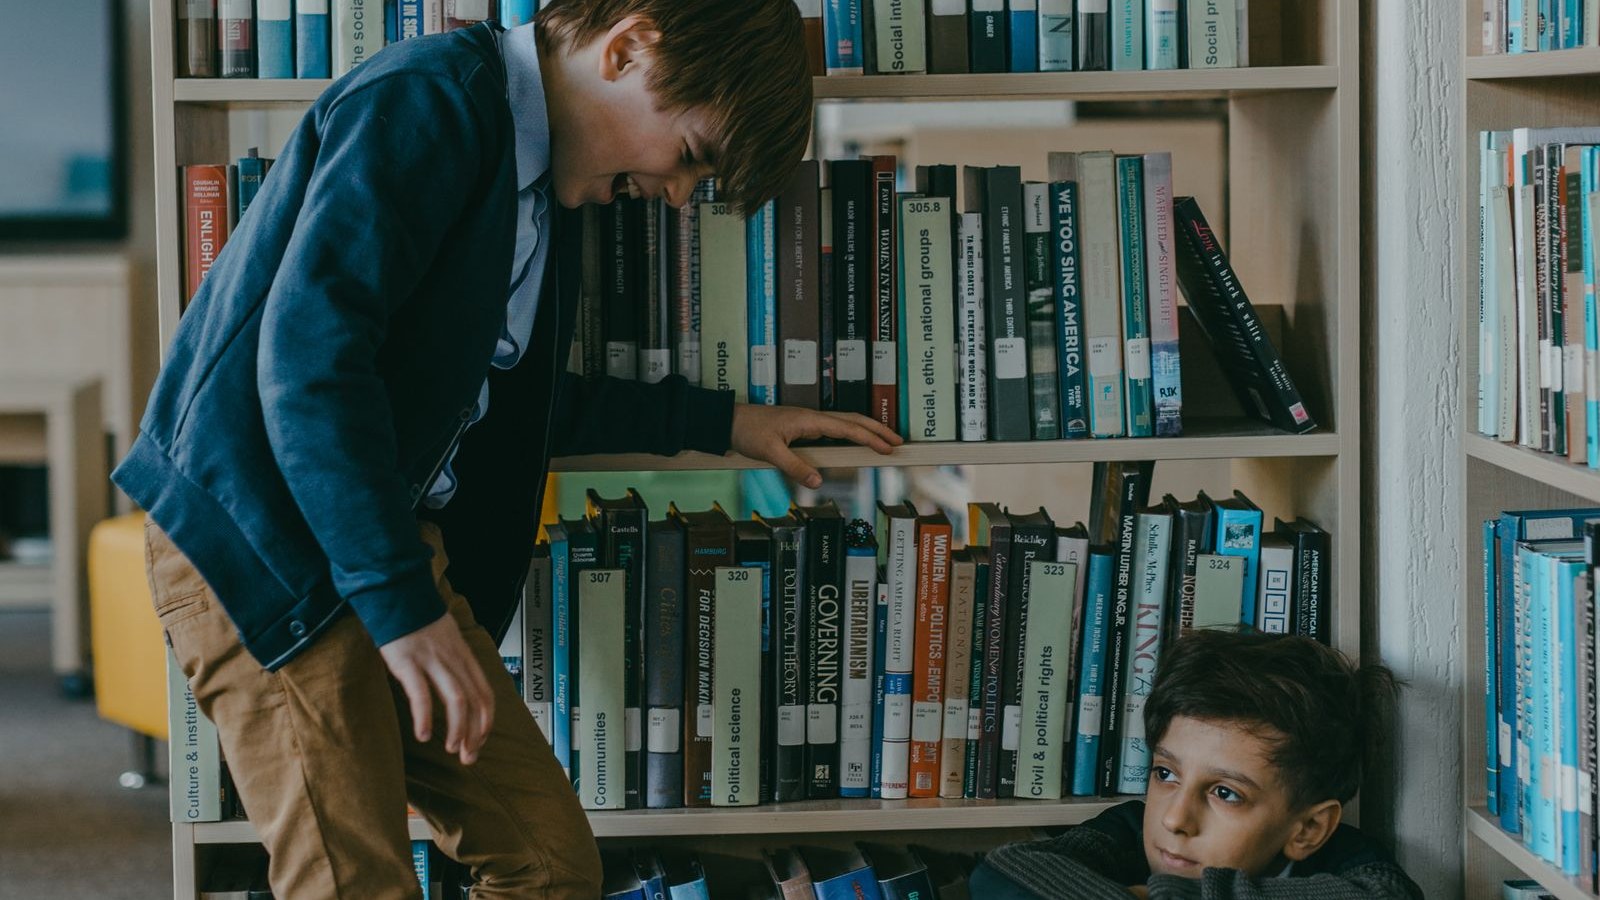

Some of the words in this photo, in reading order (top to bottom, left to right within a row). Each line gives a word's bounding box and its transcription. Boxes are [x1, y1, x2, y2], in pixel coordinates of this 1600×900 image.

[350, 0, 364, 40] socia
[403, 5, 417, 16] IN
[891, 27, 905, 71] Social
[1206, 20, 1217, 64] Social
[1127, 165, 1136, 181] THE
[908, 201, 941, 213] 305.8
[1057, 188, 1072, 214] WE
[1551, 166, 1561, 218] Principles
[846, 201, 856, 220] MAJOR
[1001, 206, 1010, 227] ETHNIC
[1127, 183, 1139, 246] INTERNATIONAL
[1155, 186, 1167, 241] MARRIED
[1552, 218, 1562, 232] of
[847, 222, 856, 253] PROBLEMS
[1058, 215, 1073, 254] TOO
[1537, 203, 1546, 260] FINANCING
[795, 242, 804, 269] LIBERTY
[880, 228, 891, 269] WOMEN
[921, 229, 935, 279] groups
[1549, 233, 1561, 290] Budgetary
[847, 264, 856, 291] AMERICAN
[880, 271, 891, 286] IN
[967, 270, 975, 297] COATES
[1003, 265, 1012, 291] AMERICA
[1060, 256, 1077, 297] SING
[1131, 248, 1141, 294] ECONOMIC
[1159, 255, 1170, 296] SINGLE
[1191, 218, 1216, 253] Love
[1211, 255, 1222, 267] in
[1219, 269, 1240, 300] black
[1237, 301, 1247, 311] &
[1242, 312, 1263, 343] white
[795, 279, 804, 301] EVANS
[1005, 297, 1013, 315] THIRD
[1552, 291, 1562, 313] and
[847, 294, 856, 321] WOMEN'S
[920, 284, 935, 341] national
[1132, 295, 1142, 323] ORDER
[847, 323, 856, 341] HISTO
[967, 309, 975, 342] BETWEEN
[1062, 299, 1080, 377] AMERICA
[717, 342, 731, 391] groups
[922, 346, 937, 385] ethic,
[968, 344, 976, 358] THE
[968, 359, 976, 383] WORLD
[968, 384, 976, 398] AND
[968, 399, 976, 409] ME
[1067, 388, 1075, 406] IYER
[1073, 385, 1082, 408] DEEPA
[922, 390, 938, 438] Racial,
[610, 526, 639, 534] Castells
[781, 541, 799, 552] Held
[1014, 534, 1048, 546] Reichley
[1120, 515, 1134, 552] MARTIN
[1146, 524, 1160, 557] Schulke
[694, 547, 728, 556] HAMBURG
[820, 535, 829, 564] RANNEY
[895, 529, 905, 578] GETTING
[931, 533, 948, 582] WOMEN
[1187, 539, 1196, 566] RALPH
[1209, 559, 1231, 570] 324
[1302, 549, 1311, 569] DEAN
[556, 554, 567, 584] Single
[590, 572, 611, 583] 307
[727, 571, 749, 581] 320
[990, 553, 1007, 618] Extraordinary
[1043, 565, 1065, 576] 323
[1118, 553, 1132, 587] LUTHER
[1145, 559, 1159, 595] McPhee
[1311, 549, 1320, 593] AMERICAN
[558, 585, 567, 604] with
[699, 588, 711, 612] FOR
[784, 567, 796, 640] POLITICAL
[893, 580, 904, 626] AMERICA
[1180, 574, 1196, 628] NORTHE
[1301, 570, 1310, 612] McSWEENEY
[918, 603, 927, 622] editors
[976, 602, 985, 627] HANNAH
[1094, 593, 1104, 625] AMERICAN
[1301, 613, 1309, 631] AND
[1310, 593, 1319, 636] POLITICAL
[557, 605, 567, 647] Children
[698, 614, 711, 668] DECISION
[849, 579, 869, 680] LIBERTARIANISM
[928, 604, 945, 660] POLITICS
[954, 585, 969, 667] NATIONAL
[988, 617, 1002, 665] WOMEN
[1092, 627, 1102, 653] INDIANS
[1134, 603, 1160, 675] KING
[532, 628, 544, 669] FAMILY
[809, 640, 816, 648] TO
[816, 584, 839, 703] GOVERNING
[892, 628, 902, 663] RIGHT
[784, 642, 796, 696] THEORY
[990, 664, 1001, 675] in
[1038, 645, 1054, 686] rights
[1090, 664, 1099, 682] THIRD
[532, 673, 545, 701] AND
[556, 673, 568, 715] Krueger
[984, 674, 999, 732] POLITICS
[1586, 589, 1598, 795] MICROECONOMICS
[728, 687, 741, 743] science
[1035, 690, 1049, 746] political
[185, 751, 198, 762] &
[594, 712, 606, 806] Communities
[912, 744, 921, 763] Temple
[1033, 750, 1046, 761] &
[728, 746, 742, 804] Political
[1030, 766, 1045, 796] Civil
[188, 766, 200, 819] Culture
